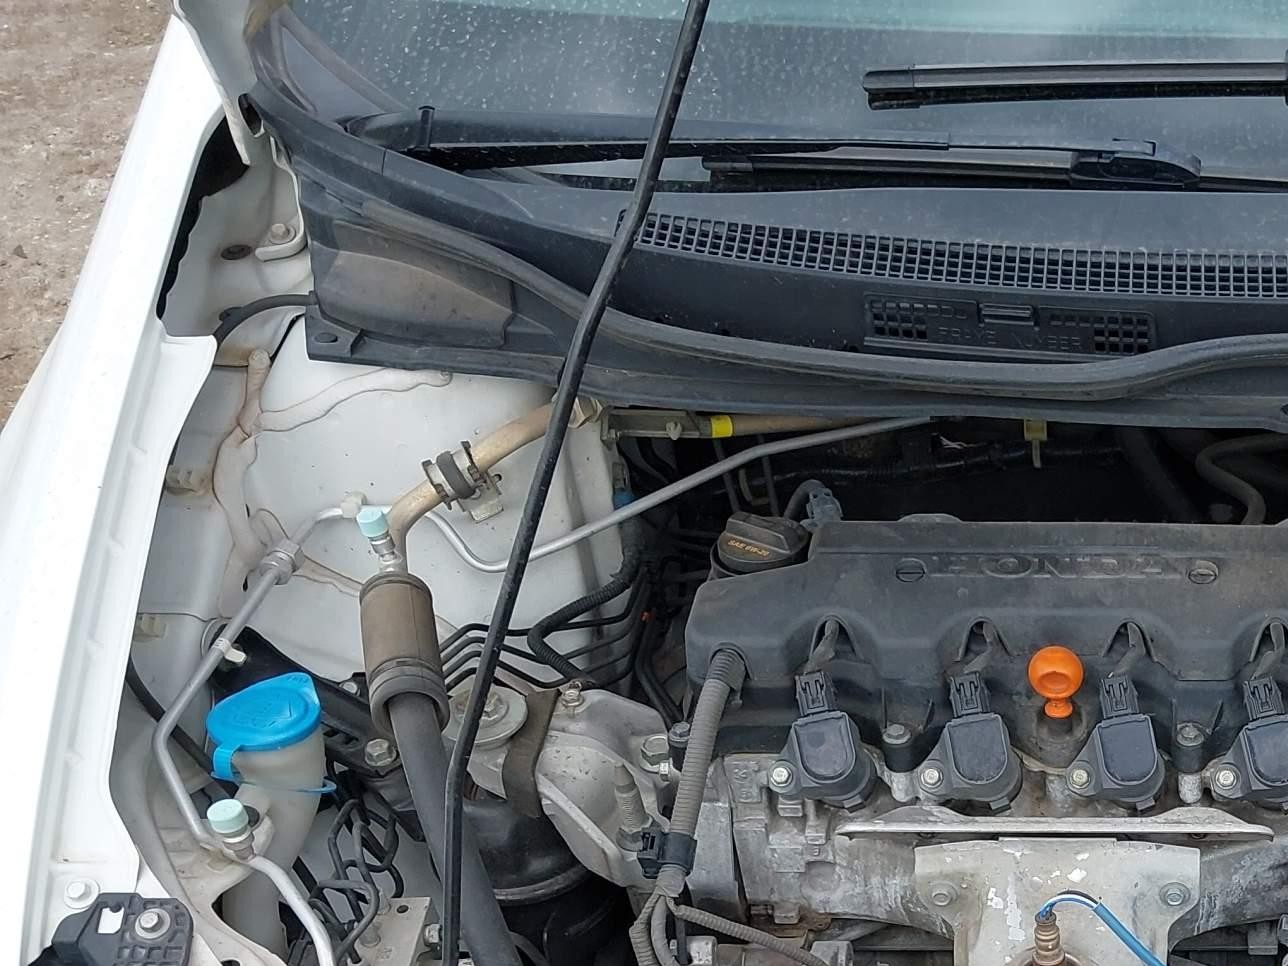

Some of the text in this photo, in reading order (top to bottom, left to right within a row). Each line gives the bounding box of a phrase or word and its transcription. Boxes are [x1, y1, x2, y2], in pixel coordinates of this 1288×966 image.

[938, 326, 1082, 351] FRAME NUMBER
[929, 555, 1182, 578] HONDA
